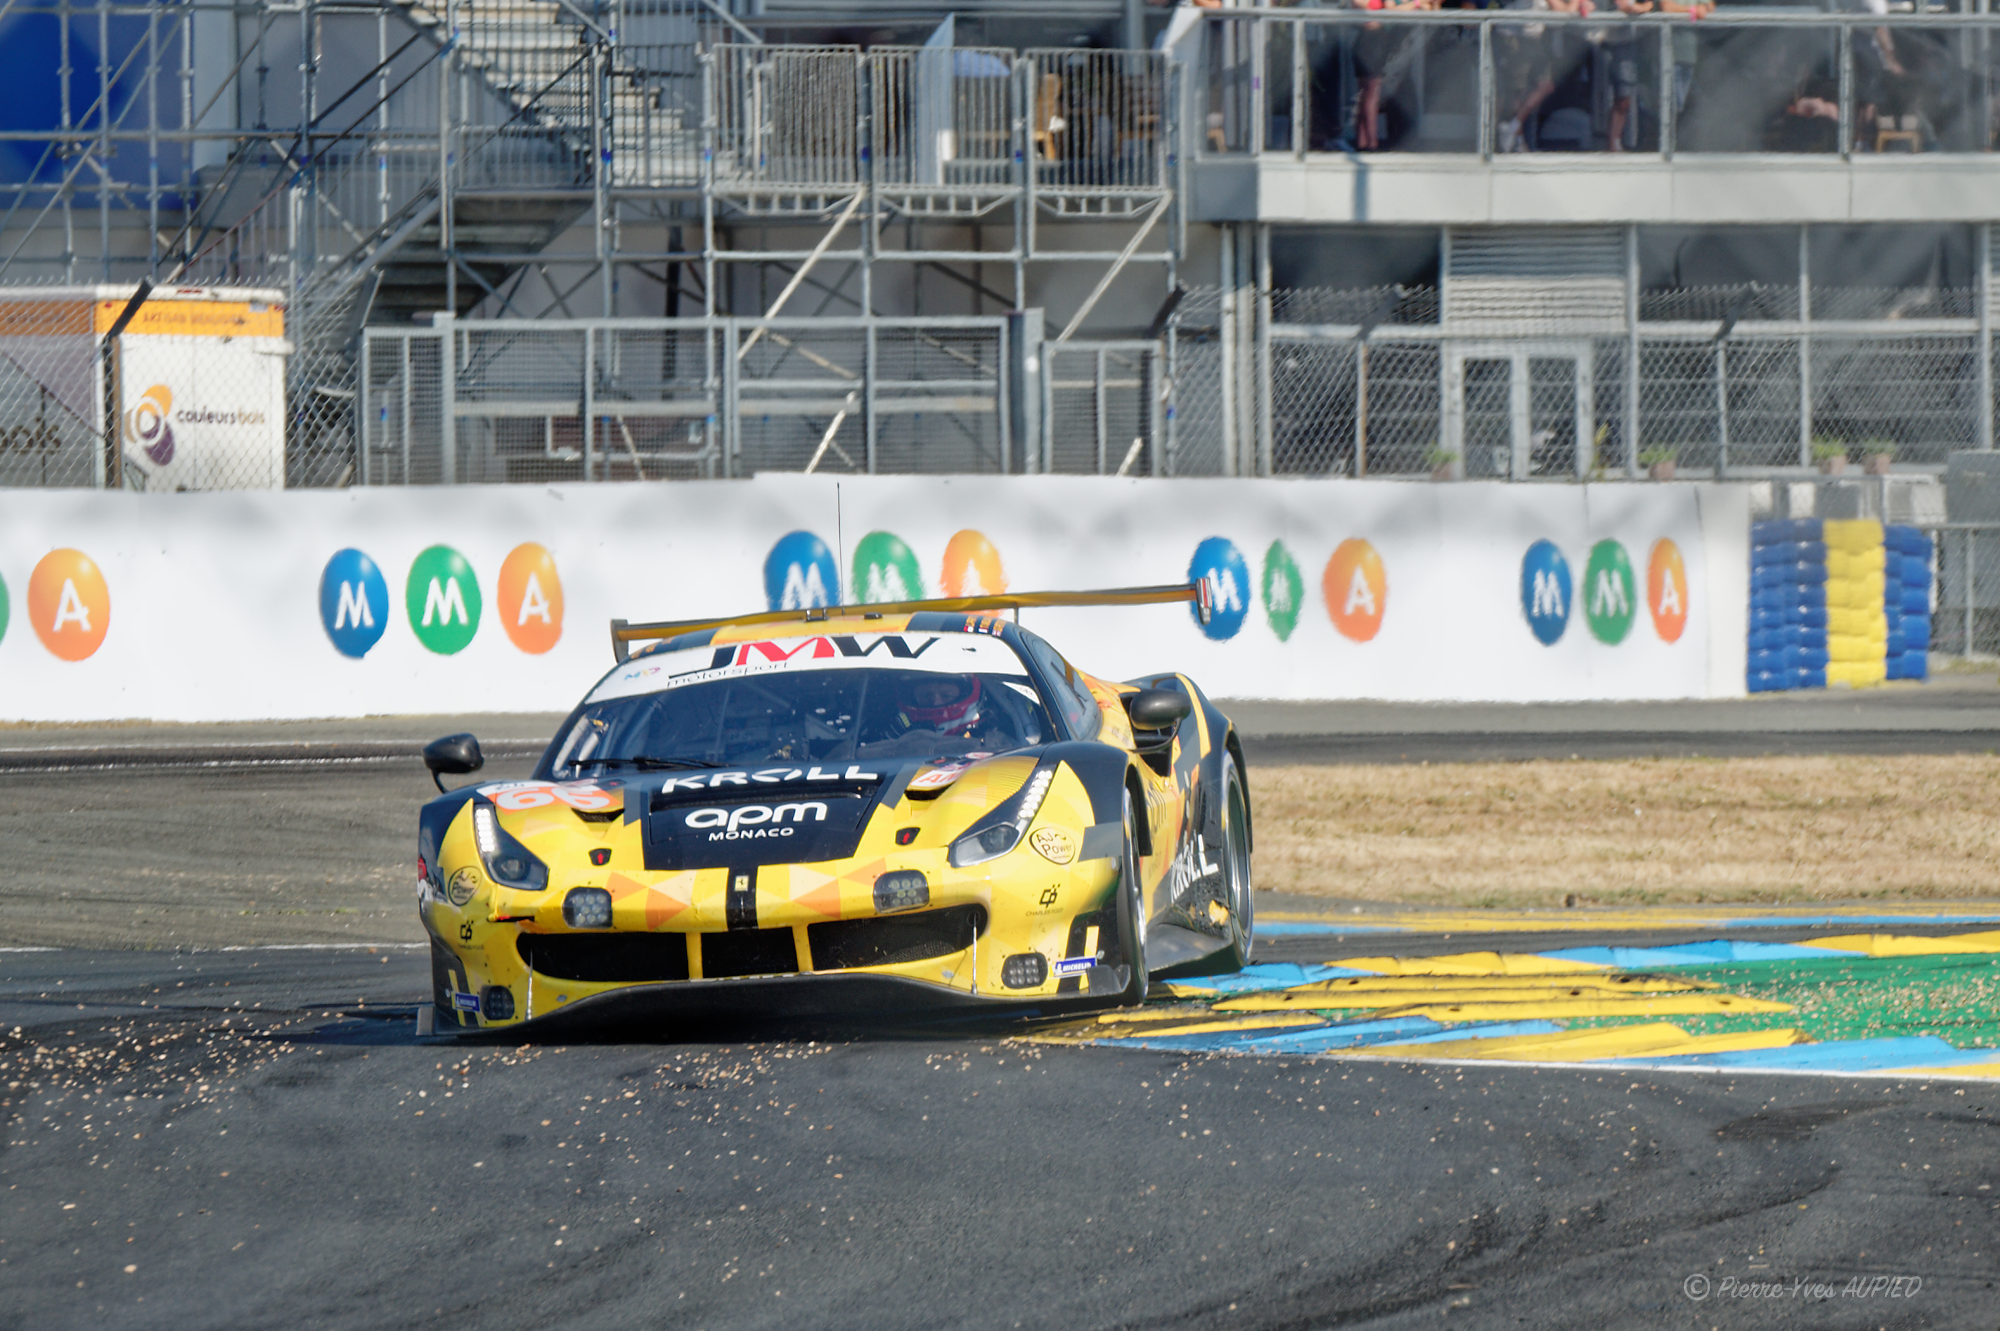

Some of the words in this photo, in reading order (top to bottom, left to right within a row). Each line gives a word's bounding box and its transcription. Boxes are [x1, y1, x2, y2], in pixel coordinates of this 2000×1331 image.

[668, 635, 940, 679] JMW
[667, 661, 789, 688] motorsport
[661, 765, 878, 794] KROLL
[497, 784, 610, 810] 66
[685, 802, 828, 831] apm
[708, 827, 794, 842] MONACO
